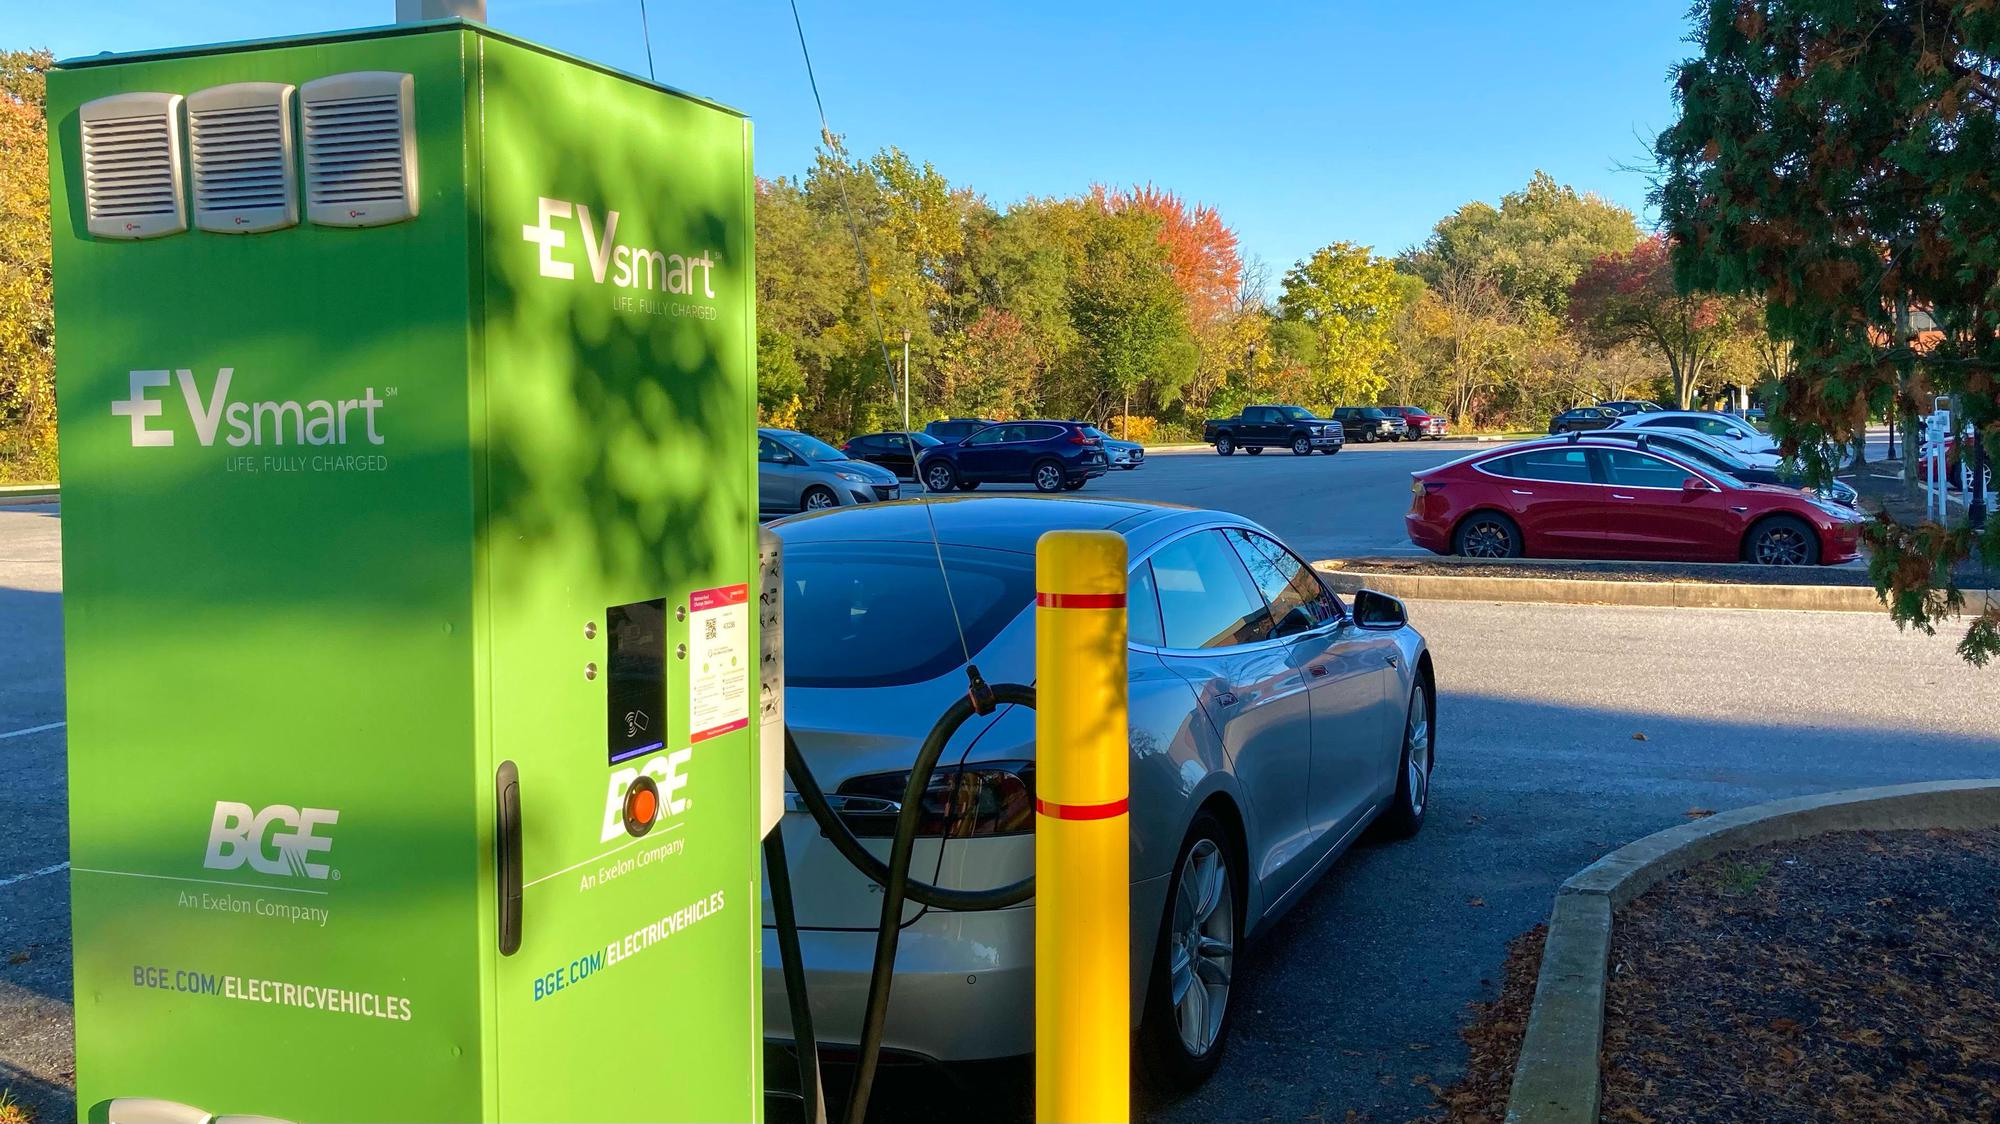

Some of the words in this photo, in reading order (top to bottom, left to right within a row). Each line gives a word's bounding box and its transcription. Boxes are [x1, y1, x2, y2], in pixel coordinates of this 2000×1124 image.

[523, 197, 715, 298] EVsmart
[640, 298, 668, 316] FULLY
[671, 303, 717, 321] CHARGED
[112, 368, 384, 447] EVsmart
[226, 456, 259, 473] LIFE,
[264, 456, 306, 472] FULLY
[312, 456, 389, 472] CHARGED
[580, 875, 596, 893] An
[599, 860, 635, 883] Exelon
[637, 838, 685, 869] Company
[178, 891, 198, 908] An
[203, 893, 251, 913] Exelon
[256, 899, 329, 927] Company
[533, 890, 725, 1002] BGE.COM/ELECTRICVEHICLES
[133, 965, 412, 1021] BGE.COM/ELECTRICVEHICLES
